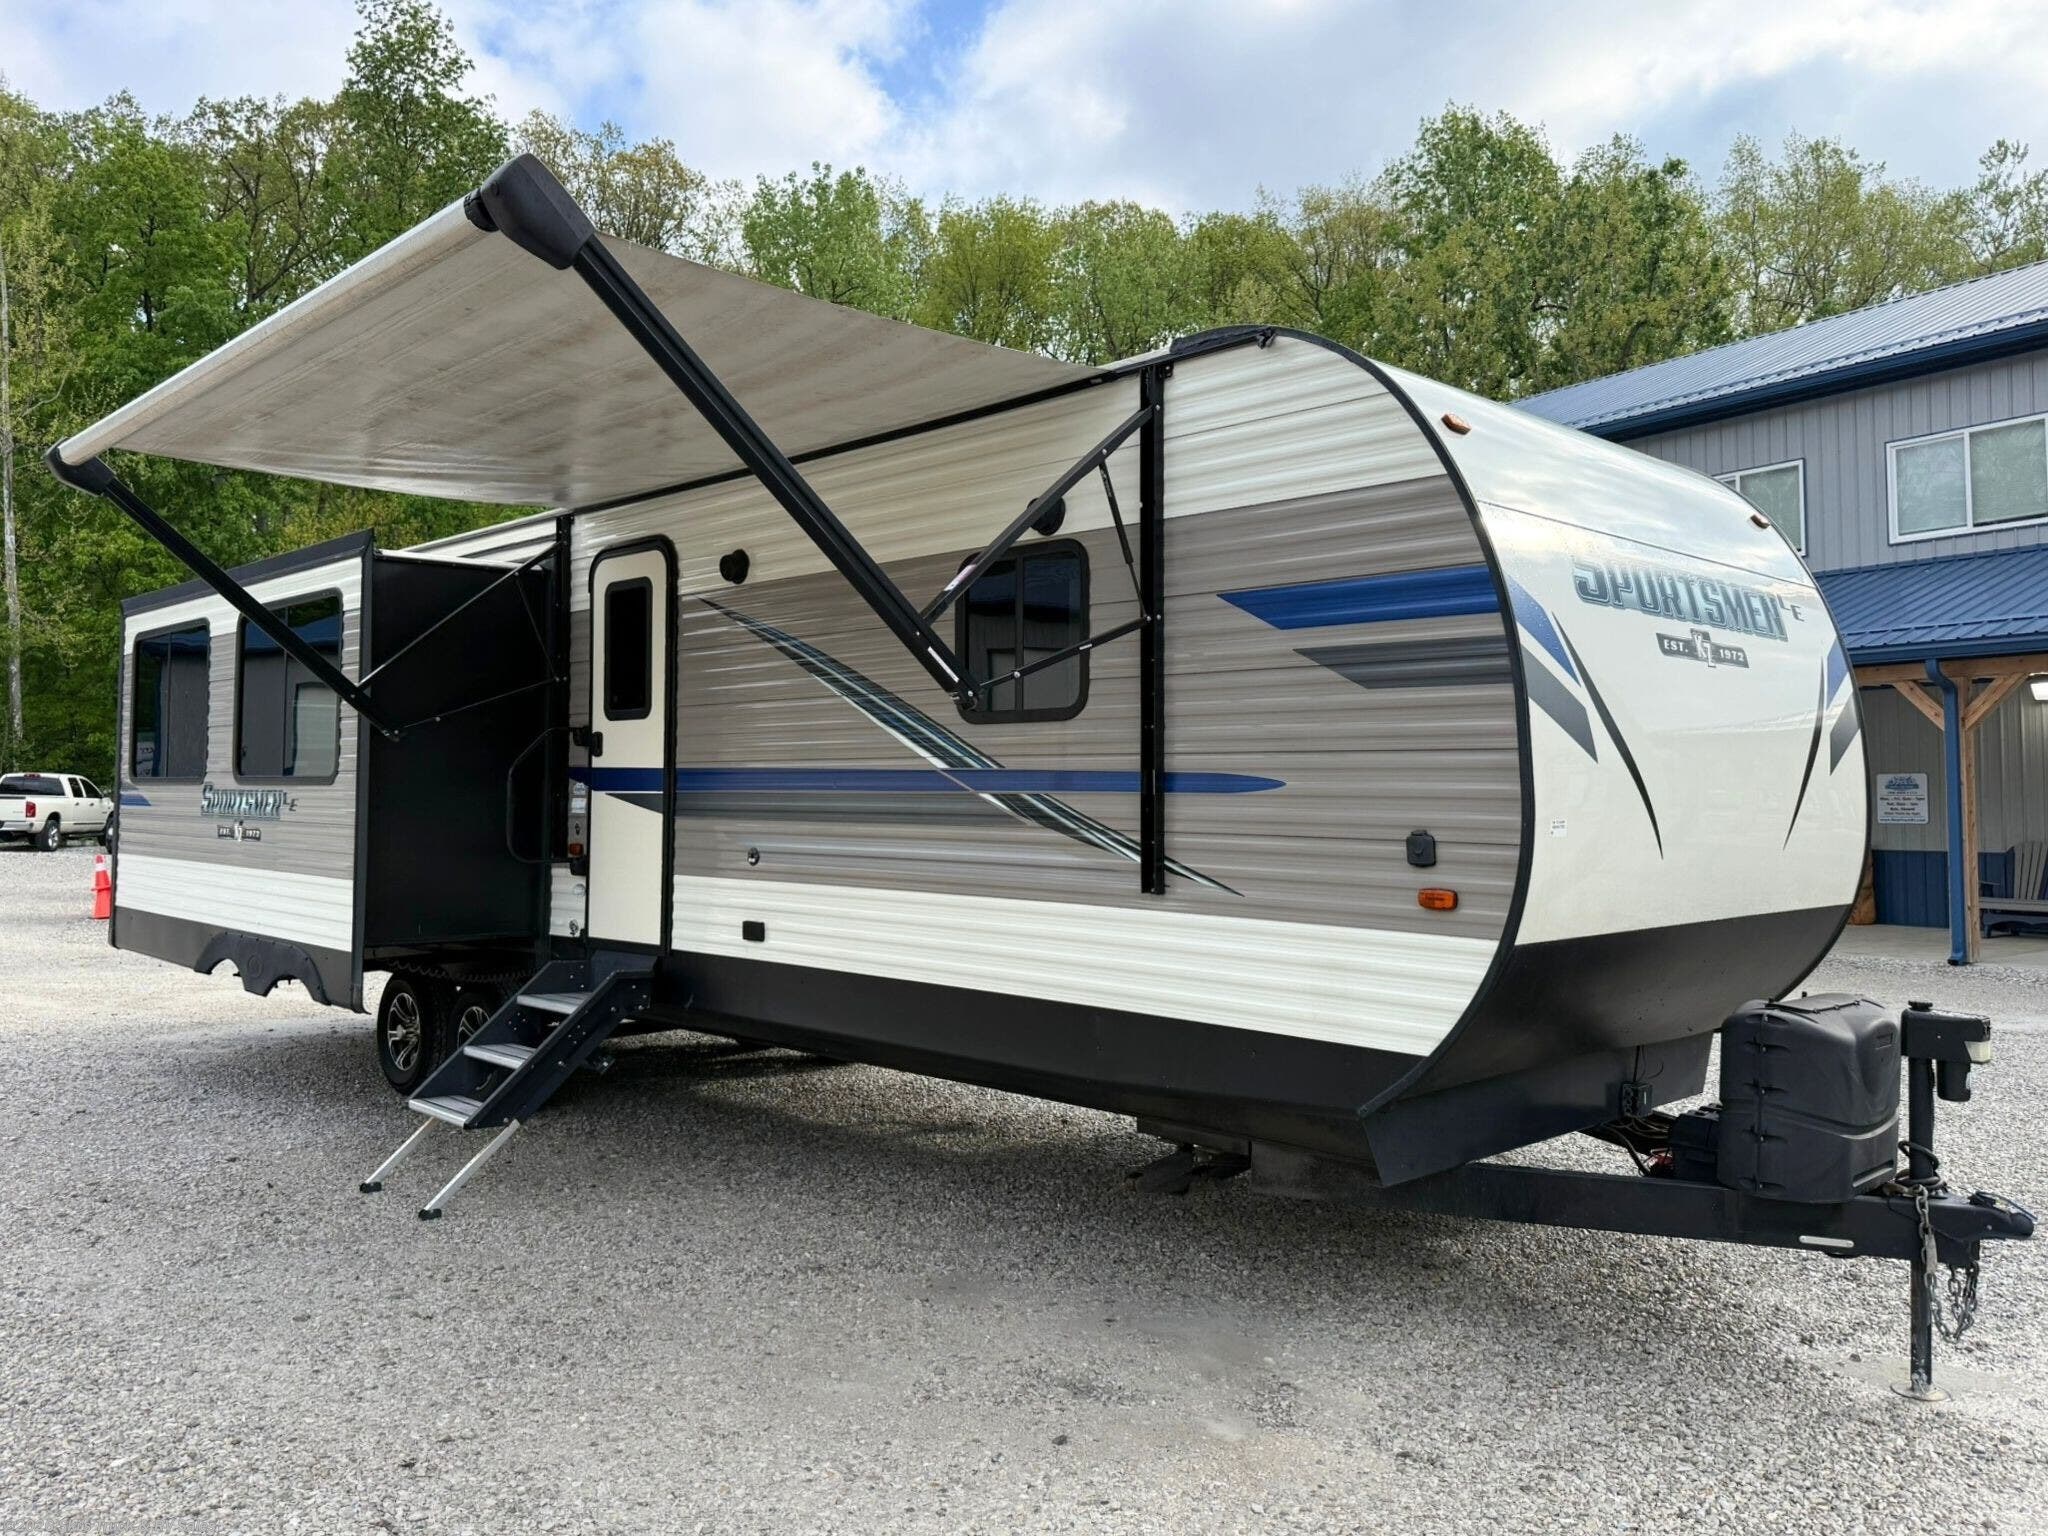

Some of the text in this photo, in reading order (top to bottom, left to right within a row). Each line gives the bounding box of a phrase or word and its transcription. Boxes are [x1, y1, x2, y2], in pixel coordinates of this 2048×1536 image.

[1573, 558, 1804, 642] SPORTSMEN LE
[1663, 632, 1745, 668] EST. KZ 1972
